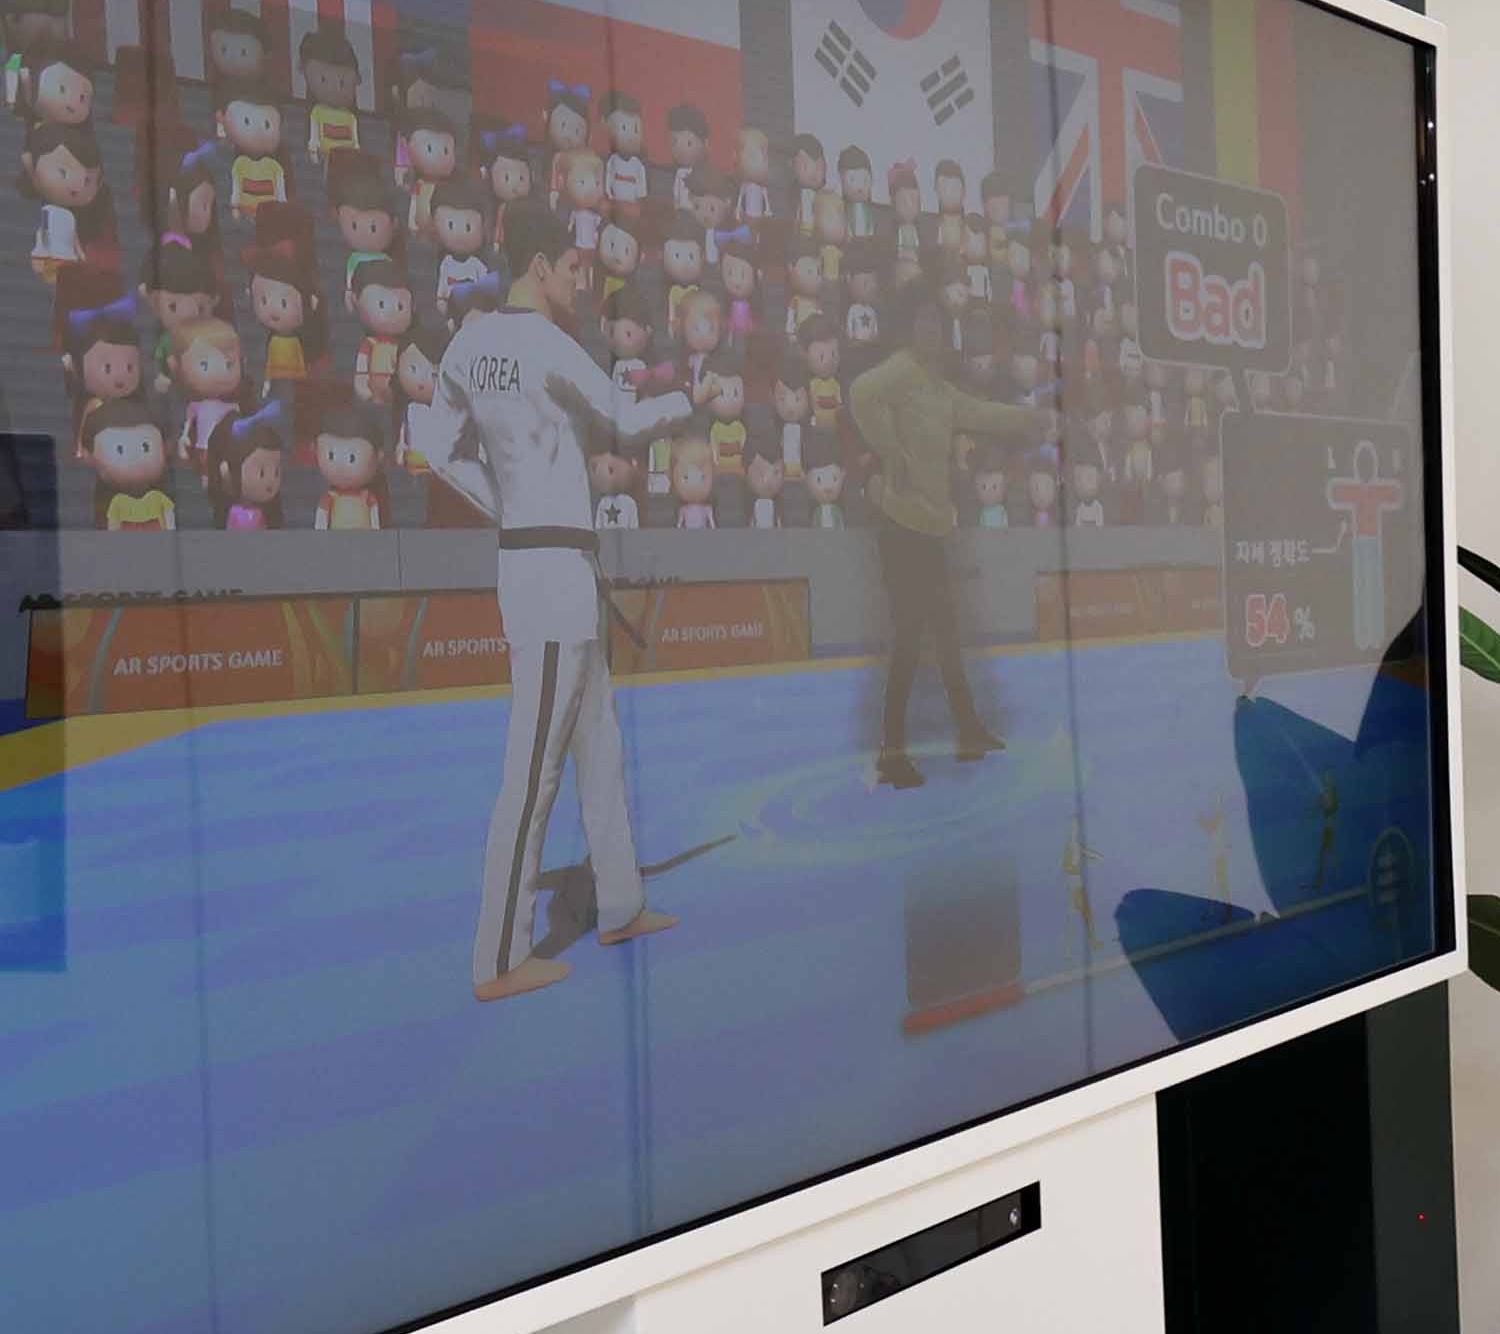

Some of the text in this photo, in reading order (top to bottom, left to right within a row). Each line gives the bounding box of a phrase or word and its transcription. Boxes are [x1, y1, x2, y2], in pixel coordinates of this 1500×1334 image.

[1156, 192, 1267, 247] Combo 0
[1166, 251, 1266, 349] Bad
[469, 355, 520, 393] KOREA
[1247, 593, 1290, 647] 54
[113, 649, 283, 676] AR SPORTS GAME
[423, 638, 507, 658] AR SPORTS
